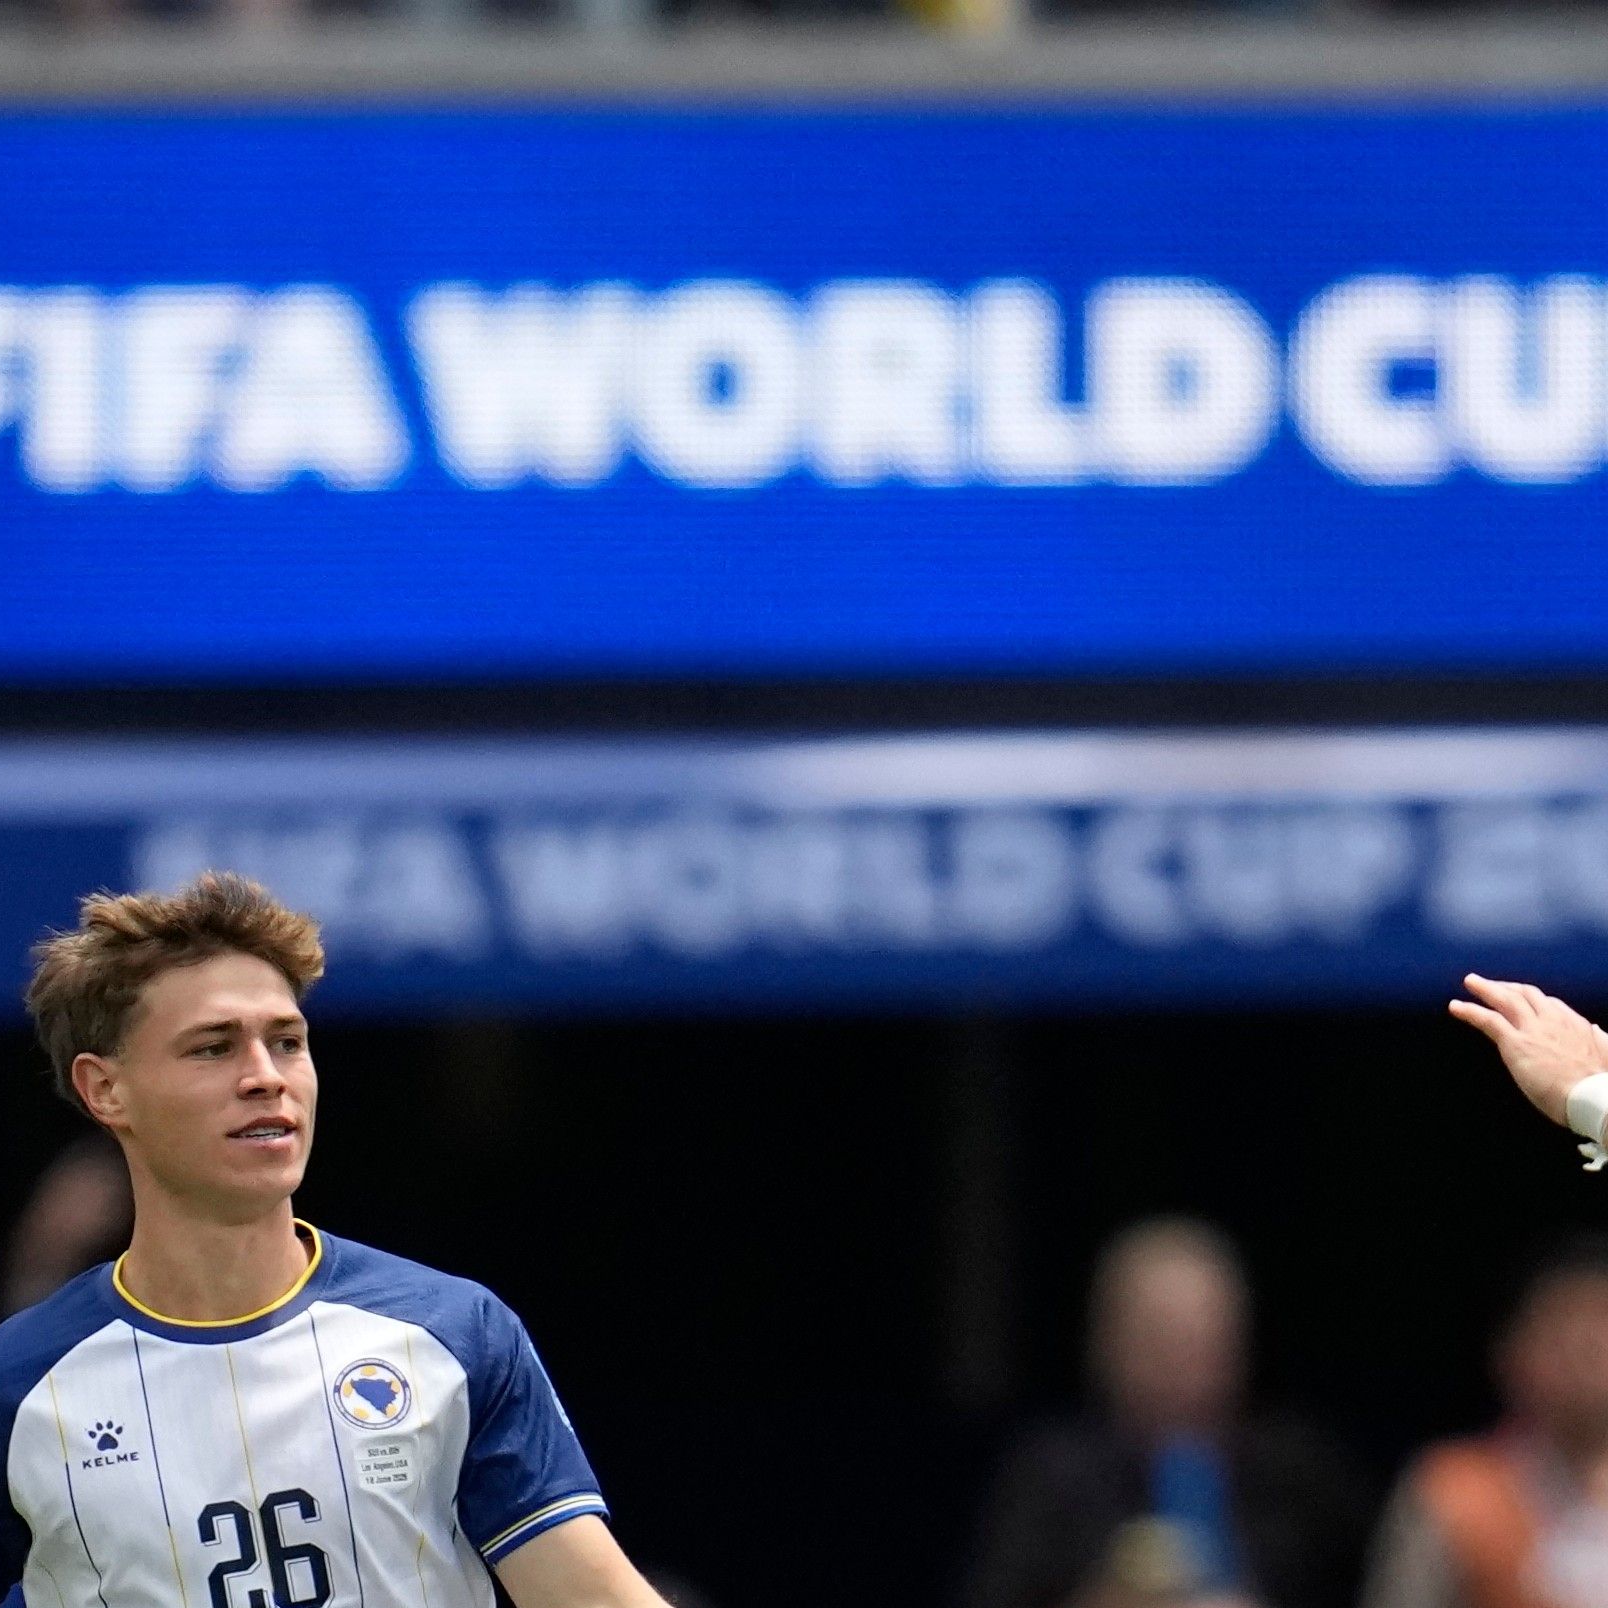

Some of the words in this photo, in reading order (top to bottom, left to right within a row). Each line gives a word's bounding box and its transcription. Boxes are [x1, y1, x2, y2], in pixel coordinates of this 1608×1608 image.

[408, 279, 1284, 489] WORLD
[497, 805, 1077, 955] WORLD
[1092, 800, 1412, 945] CUP
[82, 1451, 139, 1469] KELME
